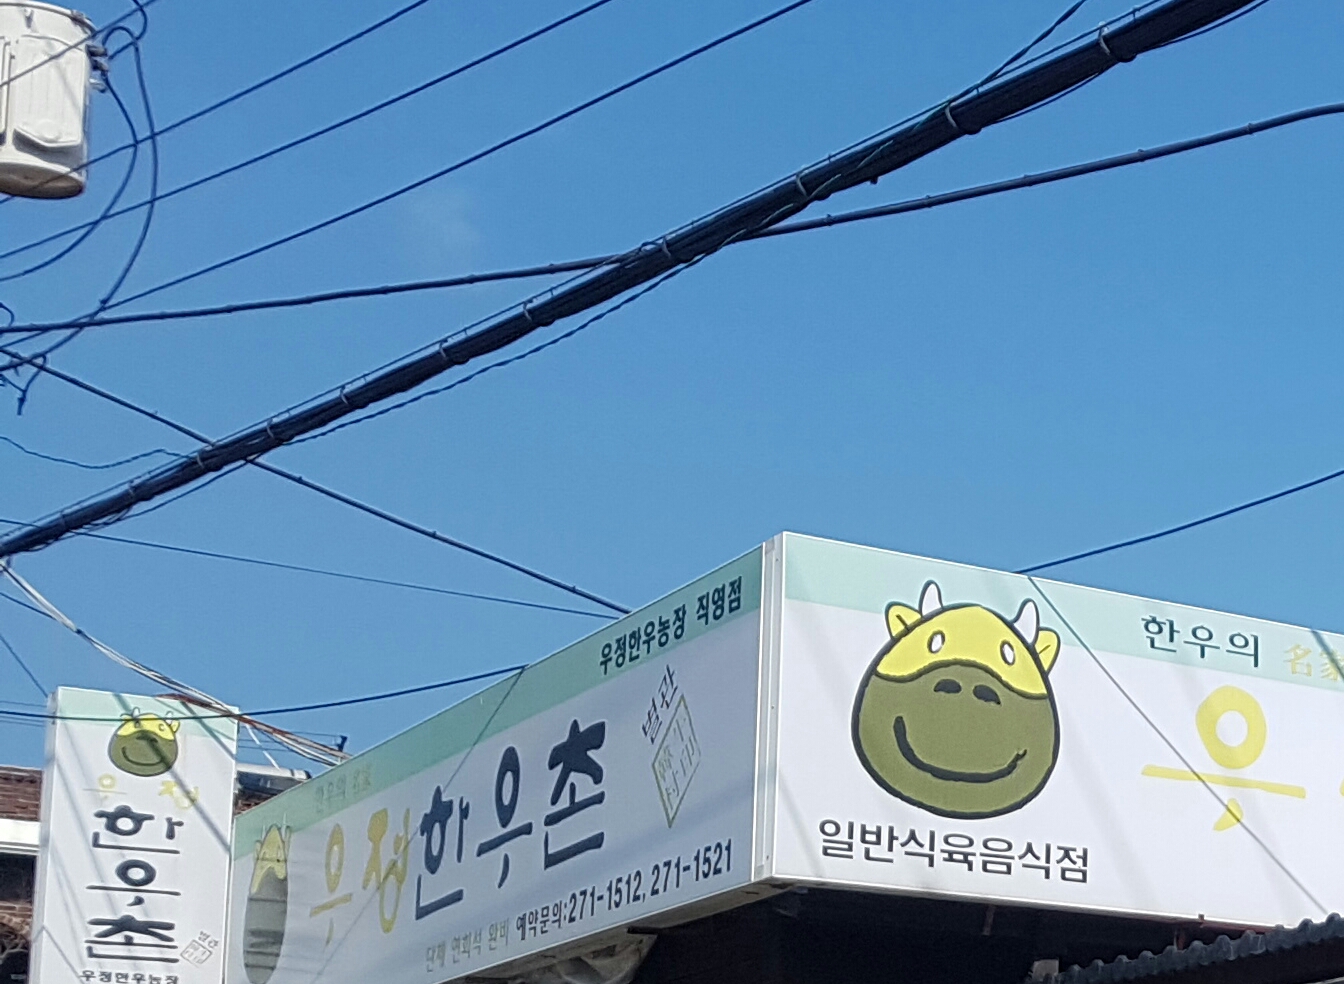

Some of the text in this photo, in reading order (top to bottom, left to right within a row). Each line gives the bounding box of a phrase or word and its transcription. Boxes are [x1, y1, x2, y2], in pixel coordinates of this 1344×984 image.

[600, 576, 742, 676] 우정한우농장 직영점
[1141, 614, 1261, 668] 한우의
[642, 664, 678, 745] 별관
[650, 838, 733, 897] 271-1521
[818, 819, 1090, 883] 일반식육음식점
